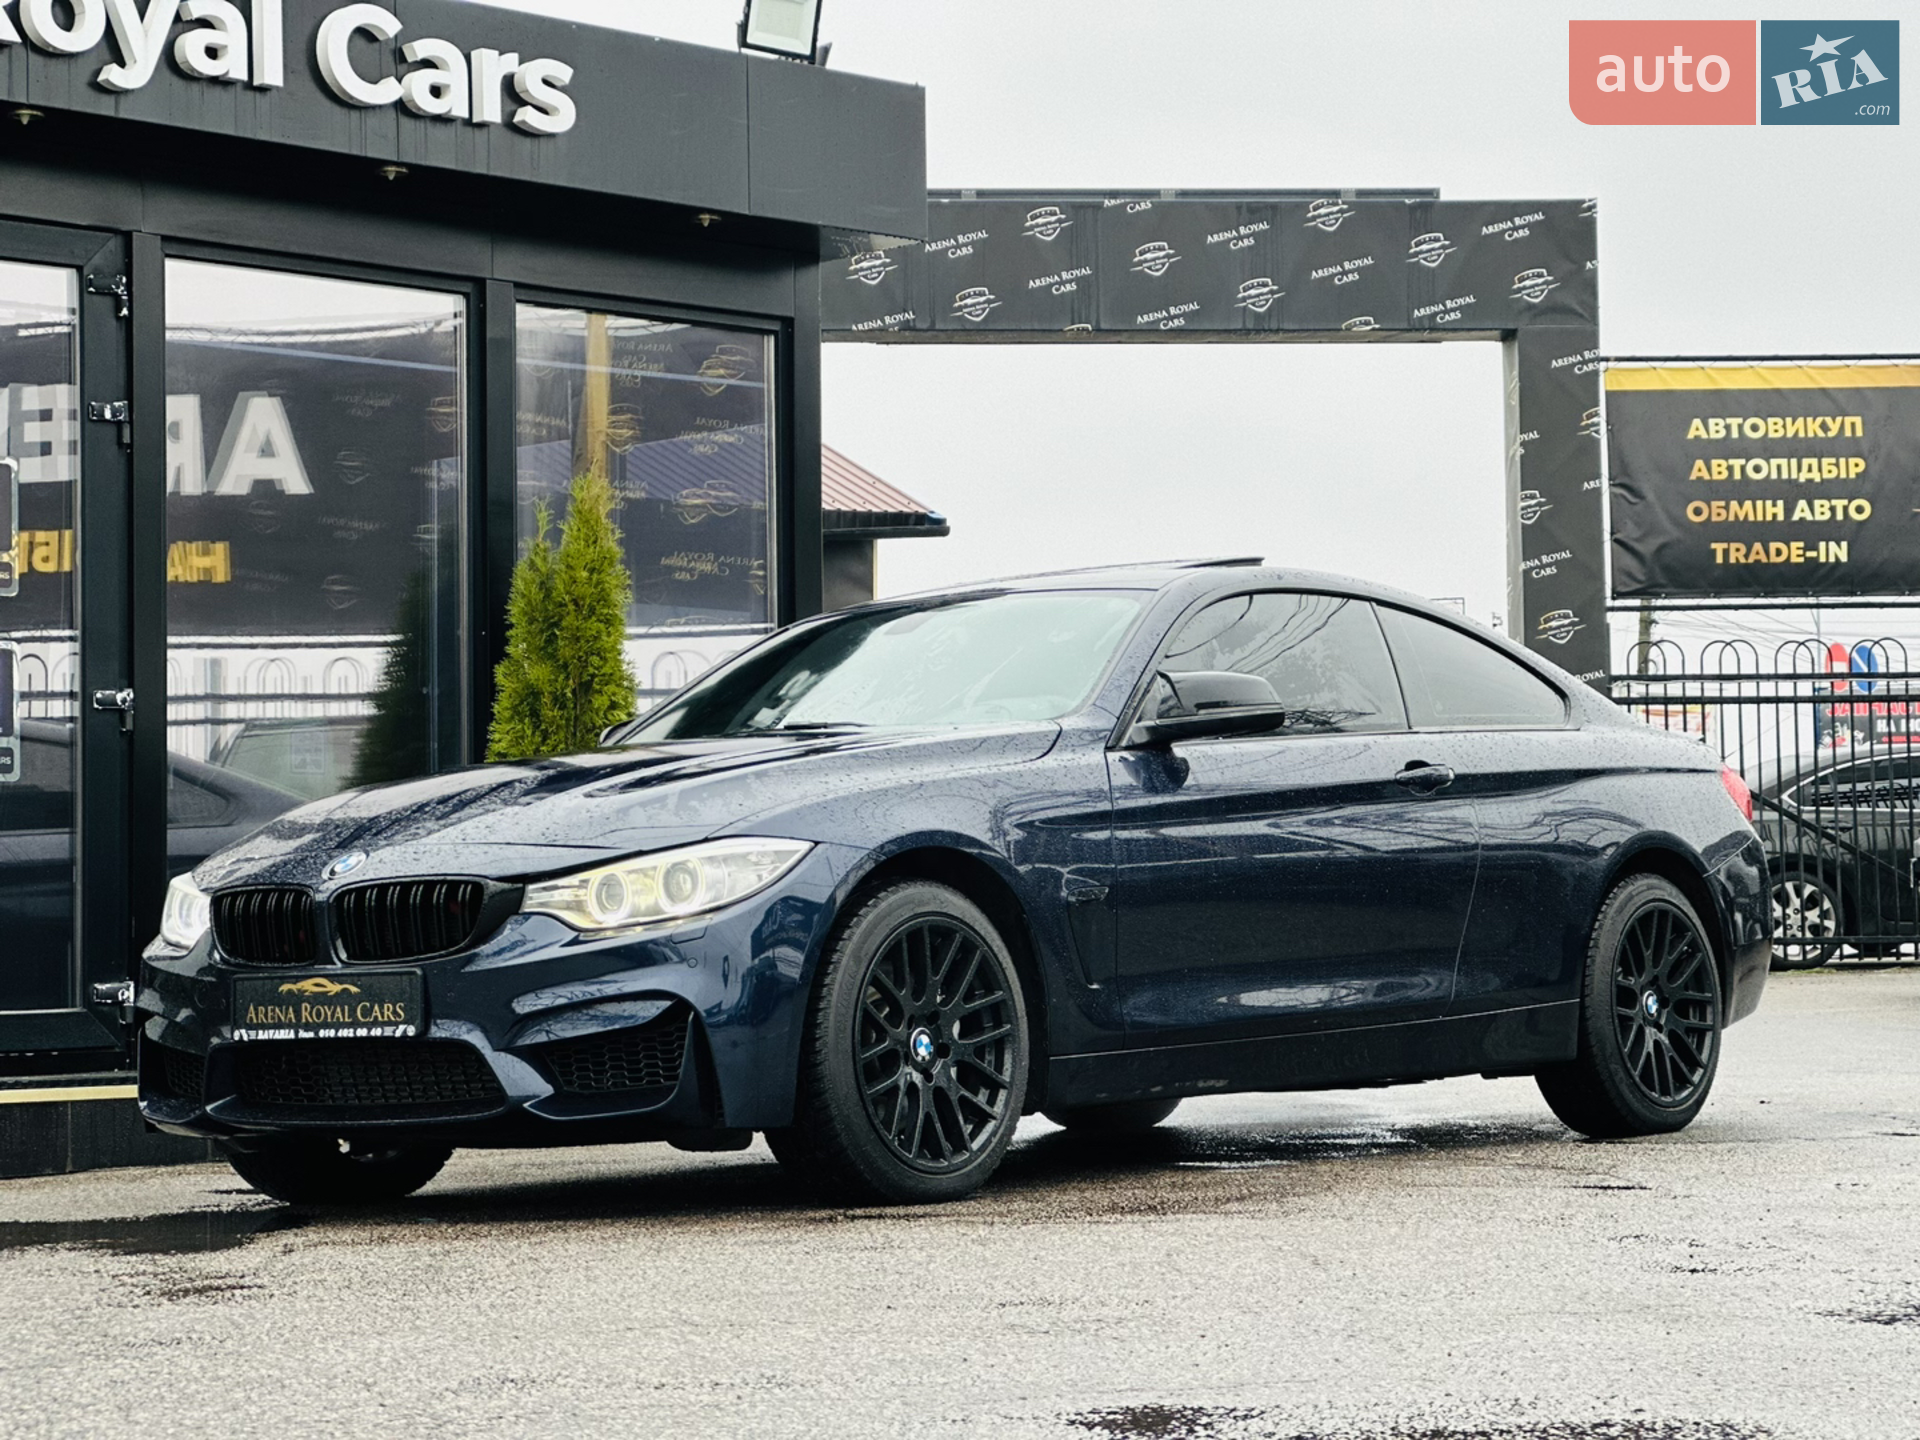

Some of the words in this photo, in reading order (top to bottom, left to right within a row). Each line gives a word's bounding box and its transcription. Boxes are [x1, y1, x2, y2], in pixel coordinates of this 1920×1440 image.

[0, 0, 284, 92] oyal
[316, 3, 577, 135] Cars
[1126, 200, 1153, 213] CARS
[1207, 229, 1238, 244] ARENA
[1239, 222, 1270, 237] ROYAL
[1481, 220, 1513, 235] ARENA
[1514, 212, 1545, 228] ROYAL
[925, 237, 956, 253] ARENA
[958, 230, 988, 247] ROYAL
[1230, 237, 1254, 250] CARS
[1504, 227, 1529, 241] CARS
[948, 245, 973, 258] CARS
[1311, 264, 1342, 279] ARENA
[1344, 256, 1374, 273] ROYAL
[1029, 273, 1060, 289] ARENA
[1061, 266, 1092, 282] ROYAL
[1335, 272, 1359, 285] CARS
[1052, 282, 1077, 295] CARS
[1137, 309, 1168, 324] ARENA
[1170, 302, 1200, 318] ROYAL
[1413, 303, 1445, 318] ARENA
[1446, 295, 1476, 311] ROYAL
[884, 310, 916, 325] ROYAL
[1160, 317, 1185, 330] CARS
[1437, 310, 1461, 323] CARS
[1551, 354, 1583, 369] ARENA
[1574, 361, 1600, 374] CARS
[1686, 416, 1864, 439] АВТОВИКУП
[1689, 457, 1866, 482] АВТОПІДБІР
[1686, 500, 1785, 522] ОБМІН
[1791, 499, 1872, 521] АВТО
[1541, 549, 1573, 565] ROYAL
[1710, 541, 1849, 563] TRADE-IN
[1532, 565, 1557, 578] CARS
[246, 1003, 296, 1024] ARENA
[301, 1002, 352, 1023] ROYAL
[356, 1001, 405, 1022] CARS
